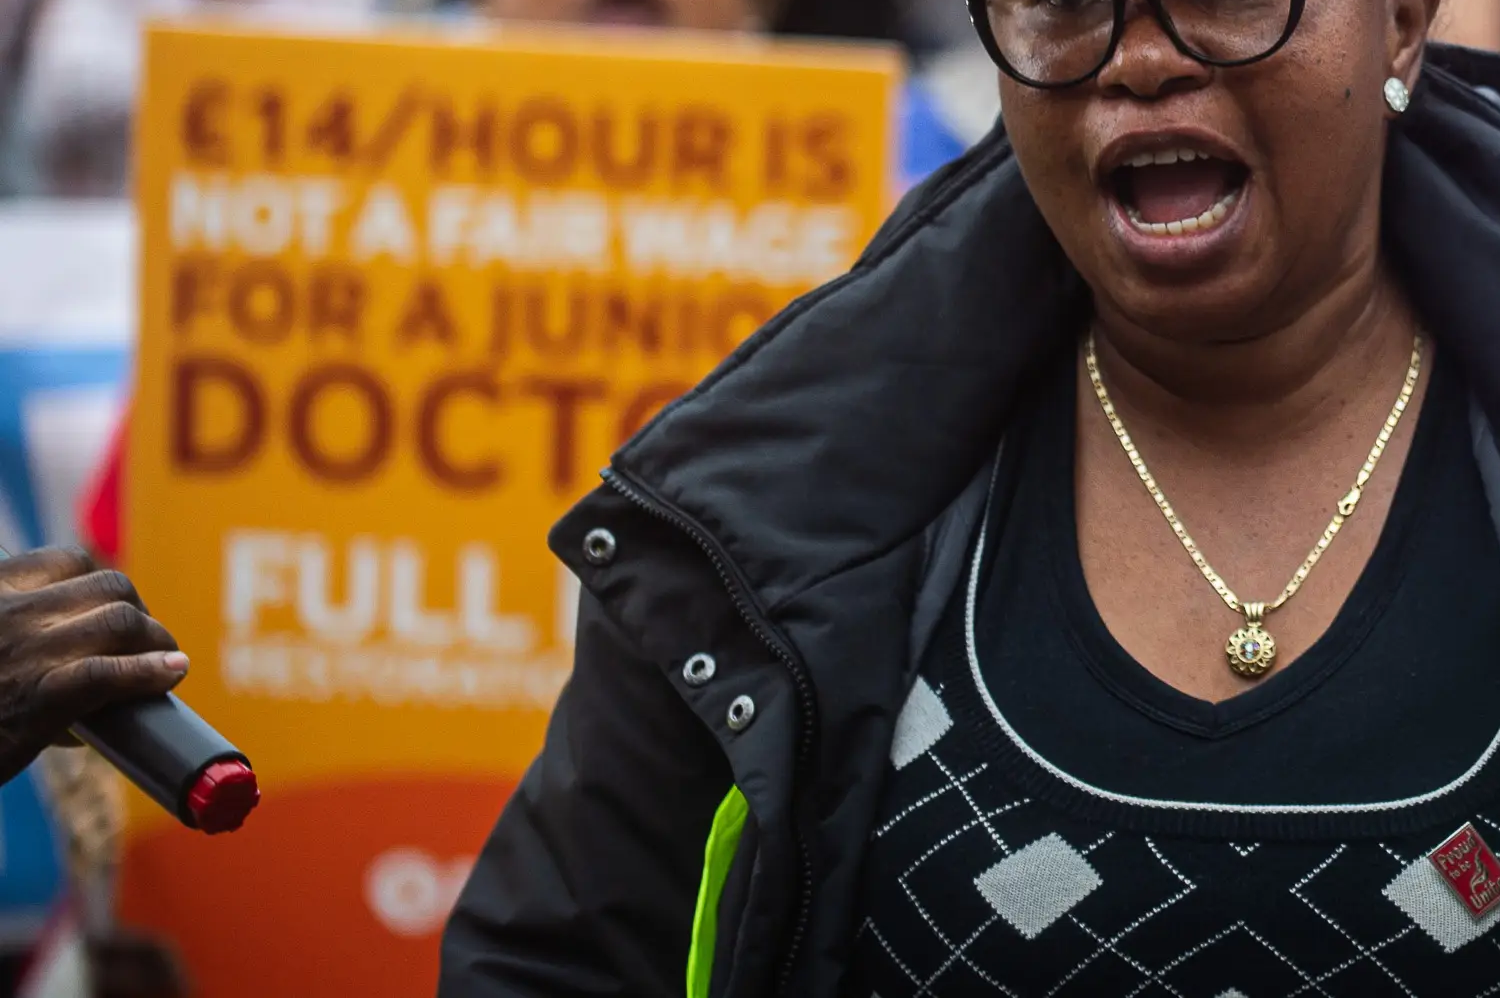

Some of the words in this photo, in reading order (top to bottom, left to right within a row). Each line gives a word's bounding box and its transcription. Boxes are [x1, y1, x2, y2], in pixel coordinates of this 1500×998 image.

[182, 82, 738, 190] £14/HOUR
[766, 114, 858, 202] IS
[172, 176, 340, 256] NOT
[352, 188, 414, 264] A
[172, 258, 362, 344] FOR
[398, 280, 458, 352] A
[172, 356, 694, 496] DOCT
[224, 528, 532, 648] FULL
